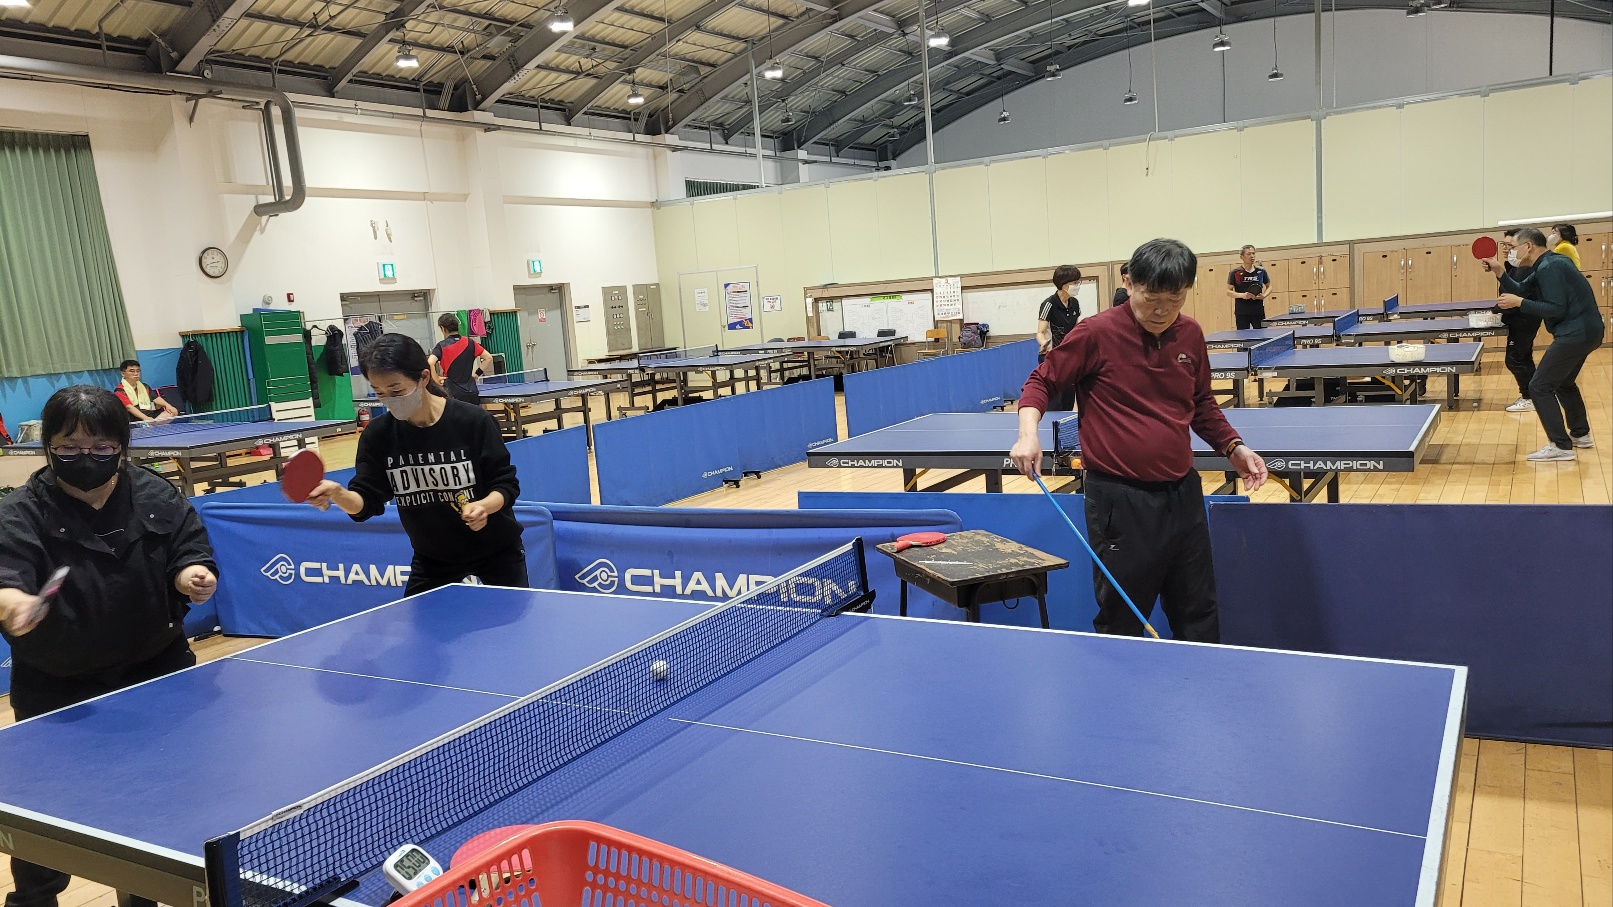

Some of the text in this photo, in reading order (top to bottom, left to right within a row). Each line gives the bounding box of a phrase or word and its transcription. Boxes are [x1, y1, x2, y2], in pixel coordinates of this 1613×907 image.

[1396, 366, 1456, 374] CHAMPION
[263, 433, 303, 444] CHAMPION
[387, 449, 467, 468] PARENTAL
[840, 459, 903, 467] CHAMPION
[1288, 460, 1384, 470] CHAMPION
[707, 466, 734, 477] CHAMPION
[389, 462, 473, 493] ADVISORY
[396, 487, 475, 507] EXPLICIT CONNT
[300, 561, 412, 587] CHAMP
